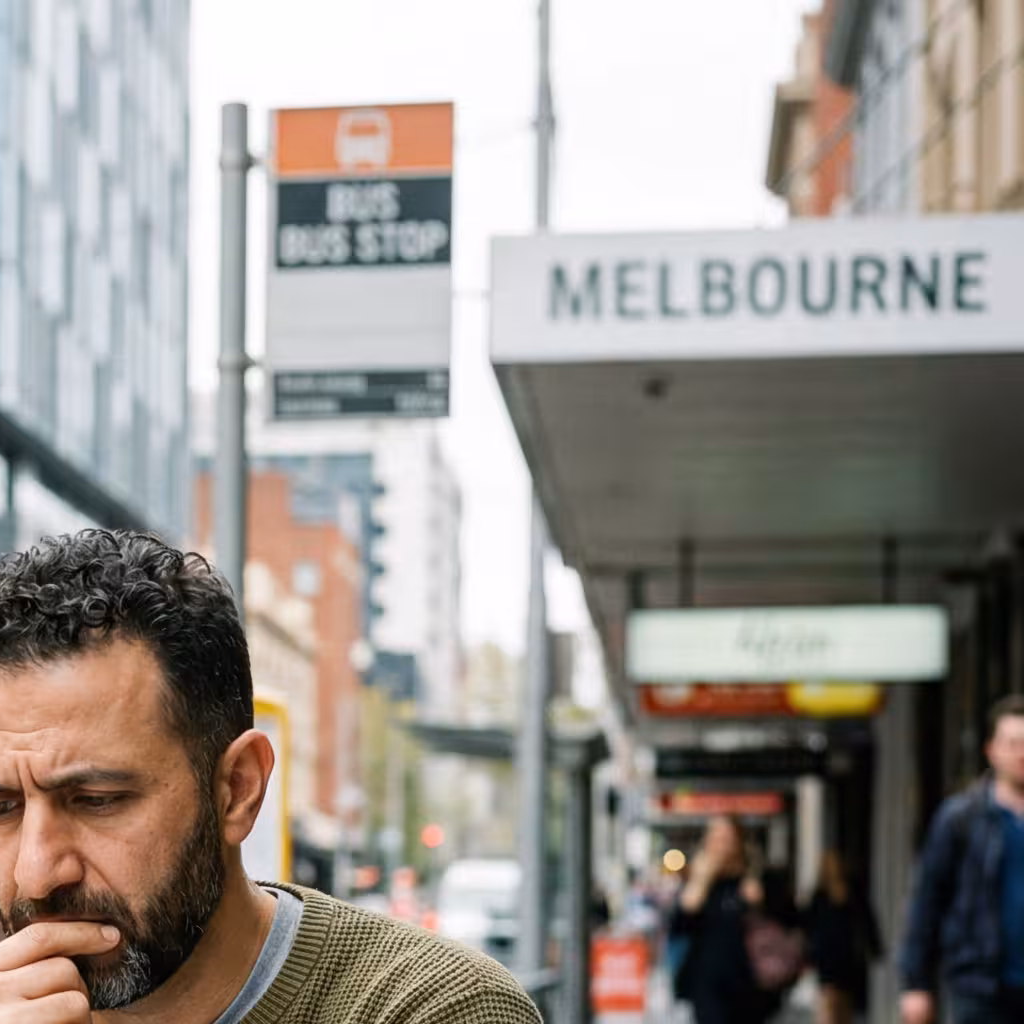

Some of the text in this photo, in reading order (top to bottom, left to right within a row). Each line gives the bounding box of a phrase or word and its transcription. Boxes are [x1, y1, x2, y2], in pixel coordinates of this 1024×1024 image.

[327, 182, 400, 221] BUS
[279, 220, 448, 264] BUS STOP
[548, 251, 987, 320] MELBOURNE
